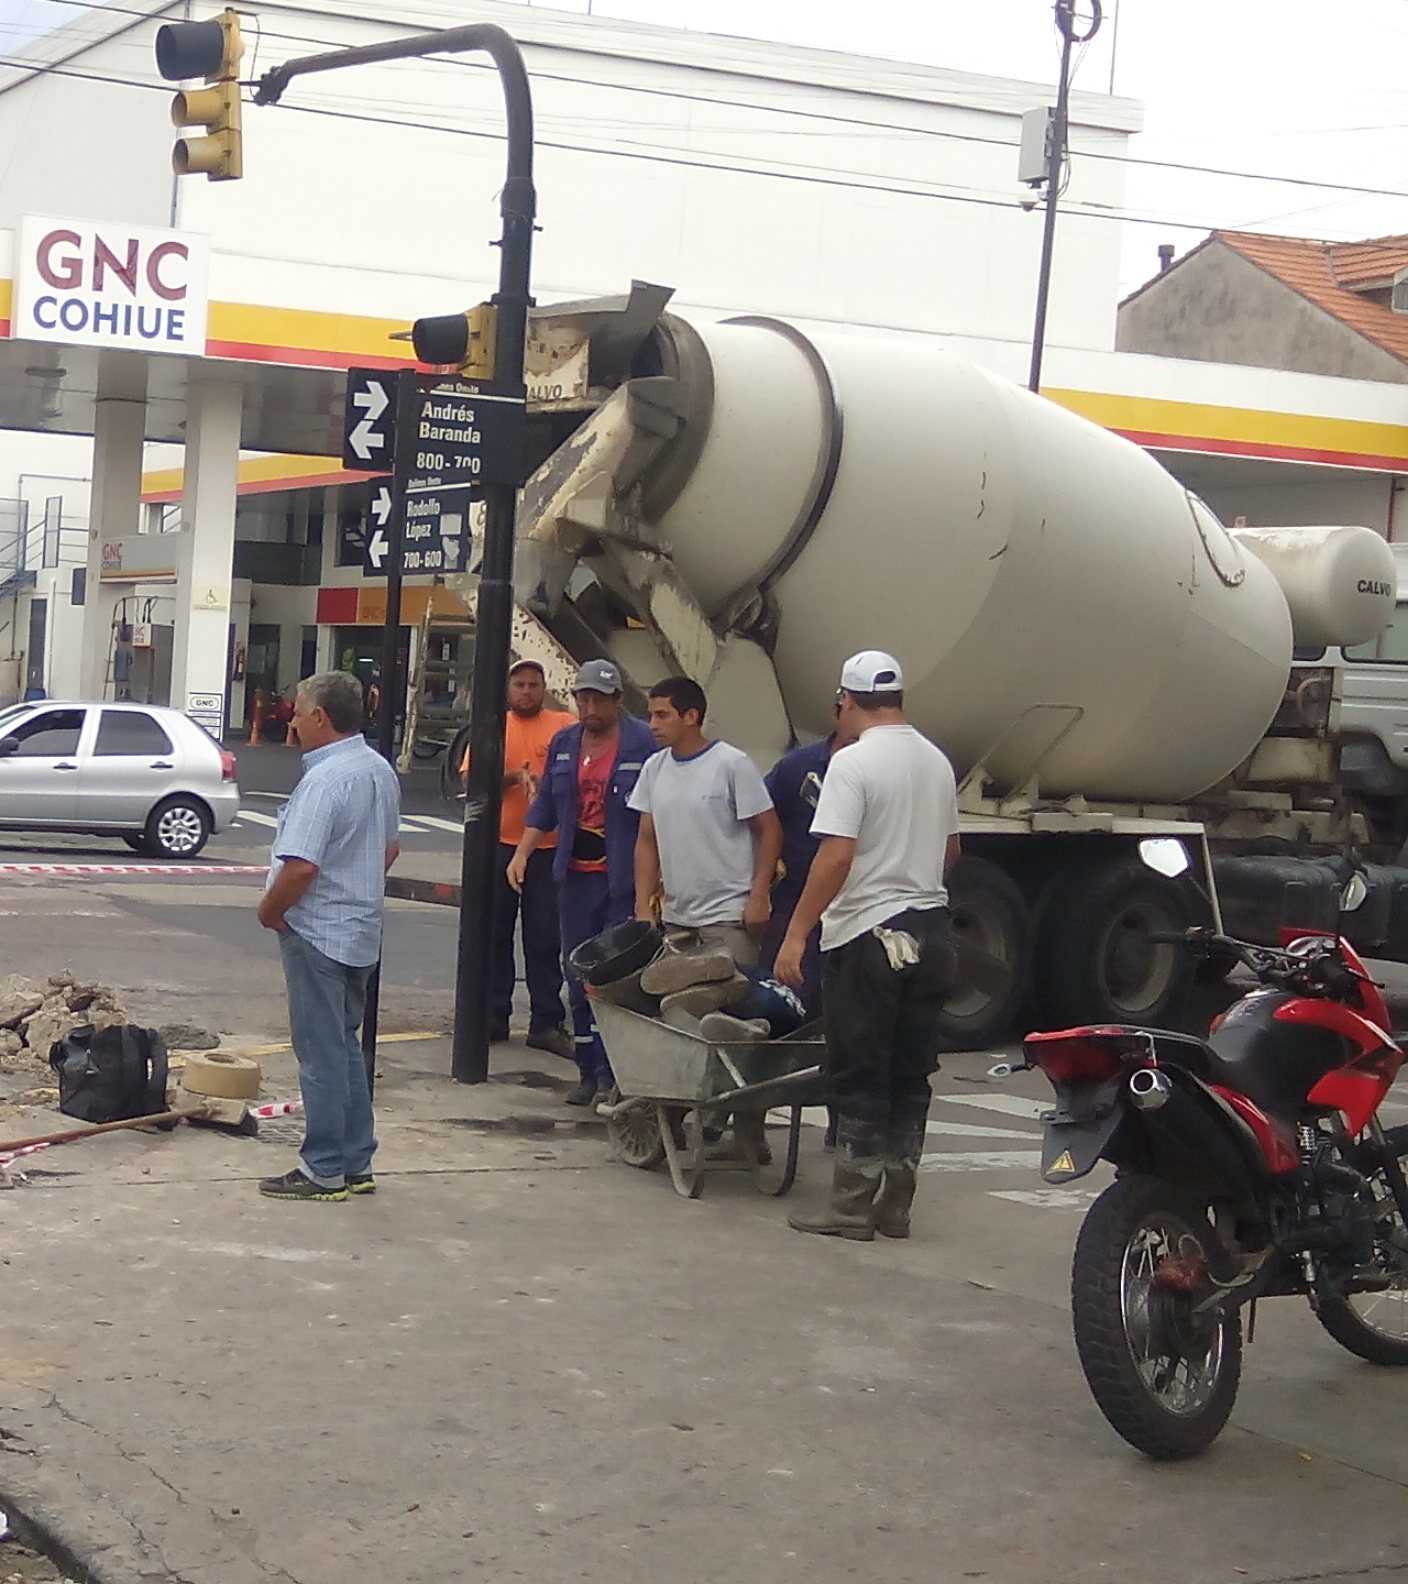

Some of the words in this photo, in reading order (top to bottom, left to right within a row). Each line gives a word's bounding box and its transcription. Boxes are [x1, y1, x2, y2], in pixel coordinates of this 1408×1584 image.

[36, 229, 189, 301] GNC
[33, 295, 185, 341] COHIUE
[528, 384, 562, 399] ALVO
[421, 401, 475, 422] Andrés
[419, 421, 481, 444] Baranda
[406, 520, 431, 541] López
